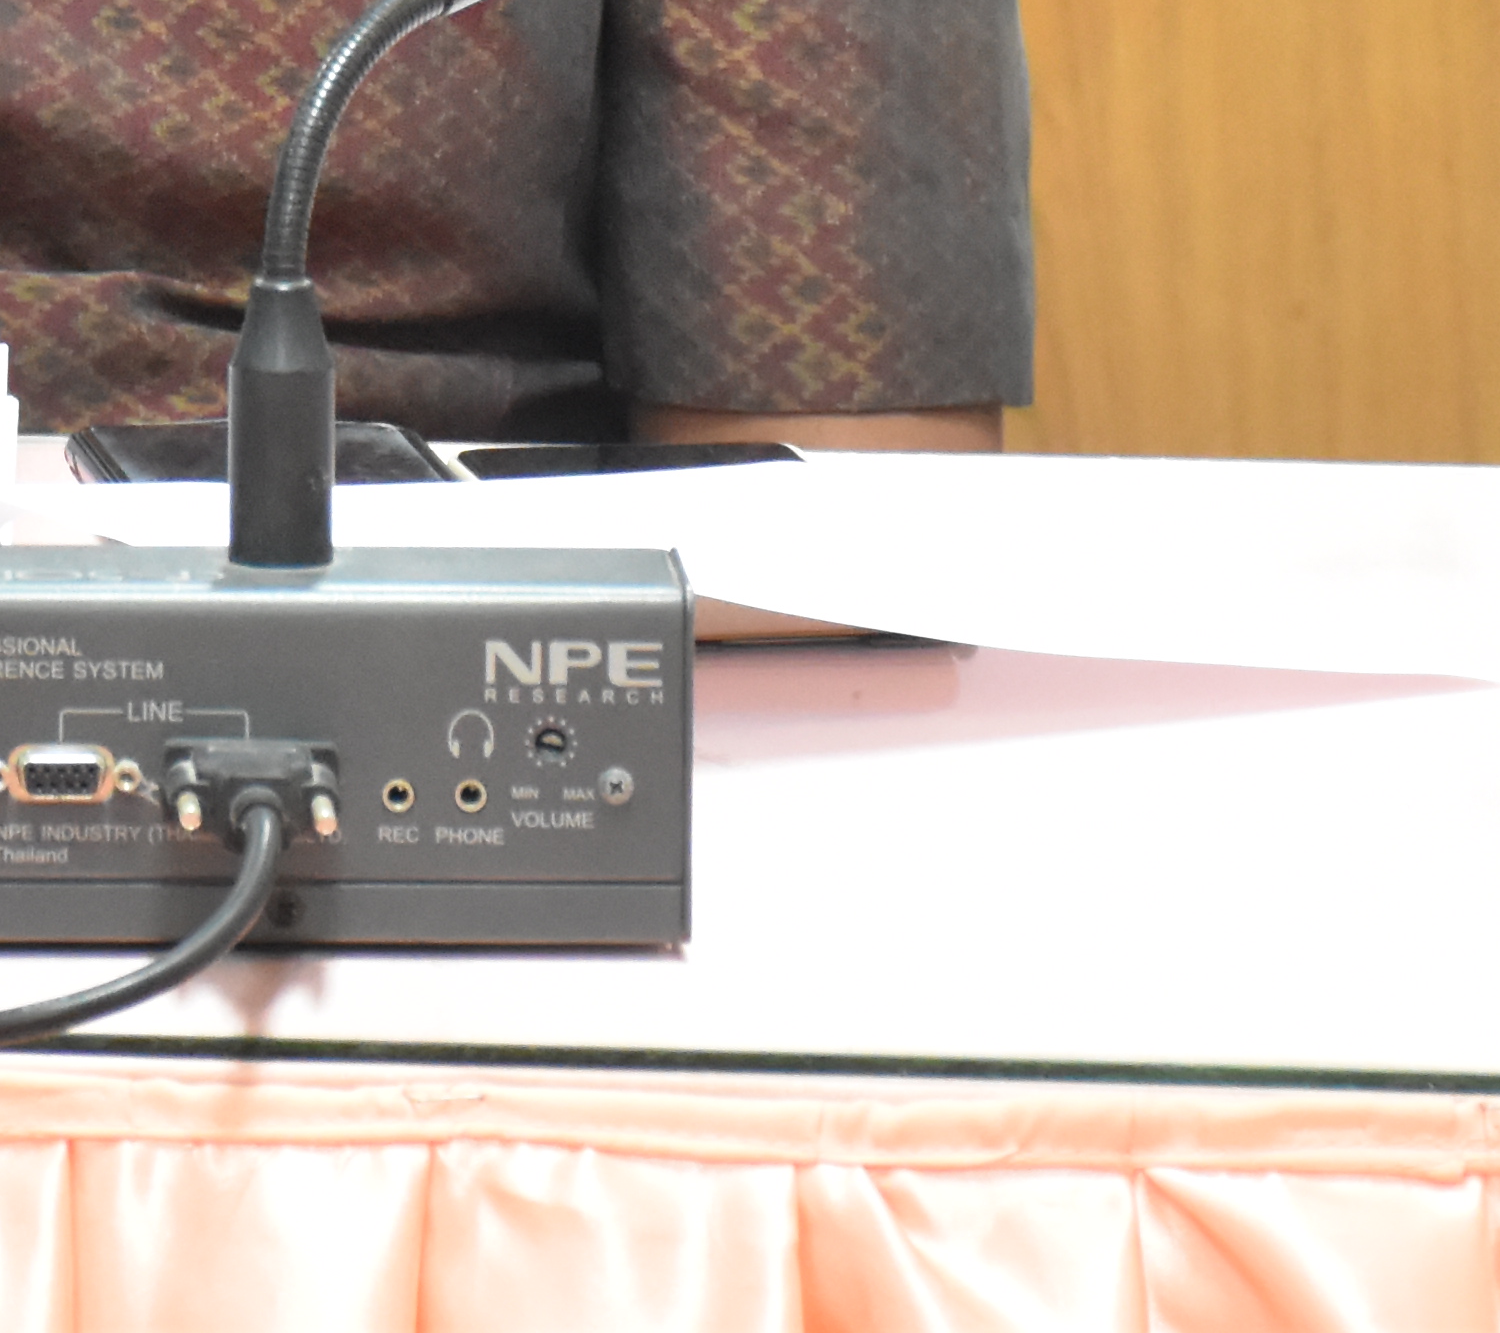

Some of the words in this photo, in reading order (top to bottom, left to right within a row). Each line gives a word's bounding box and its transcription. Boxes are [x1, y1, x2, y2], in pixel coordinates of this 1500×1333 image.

[72, 661, 165, 679] SYSTEM
[485, 640, 663, 687] NPE
[484, 689, 664, 704] RESEARCH
[127, 702, 184, 722] LINE
[511, 787, 539, 800] MIN
[563, 788, 595, 801] MAX
[511, 812, 595, 829] VOLUME
[41, 824, 141, 842] INDUSTRY
[378, 827, 419, 843] REC
[435, 828, 505, 845] PHONE
